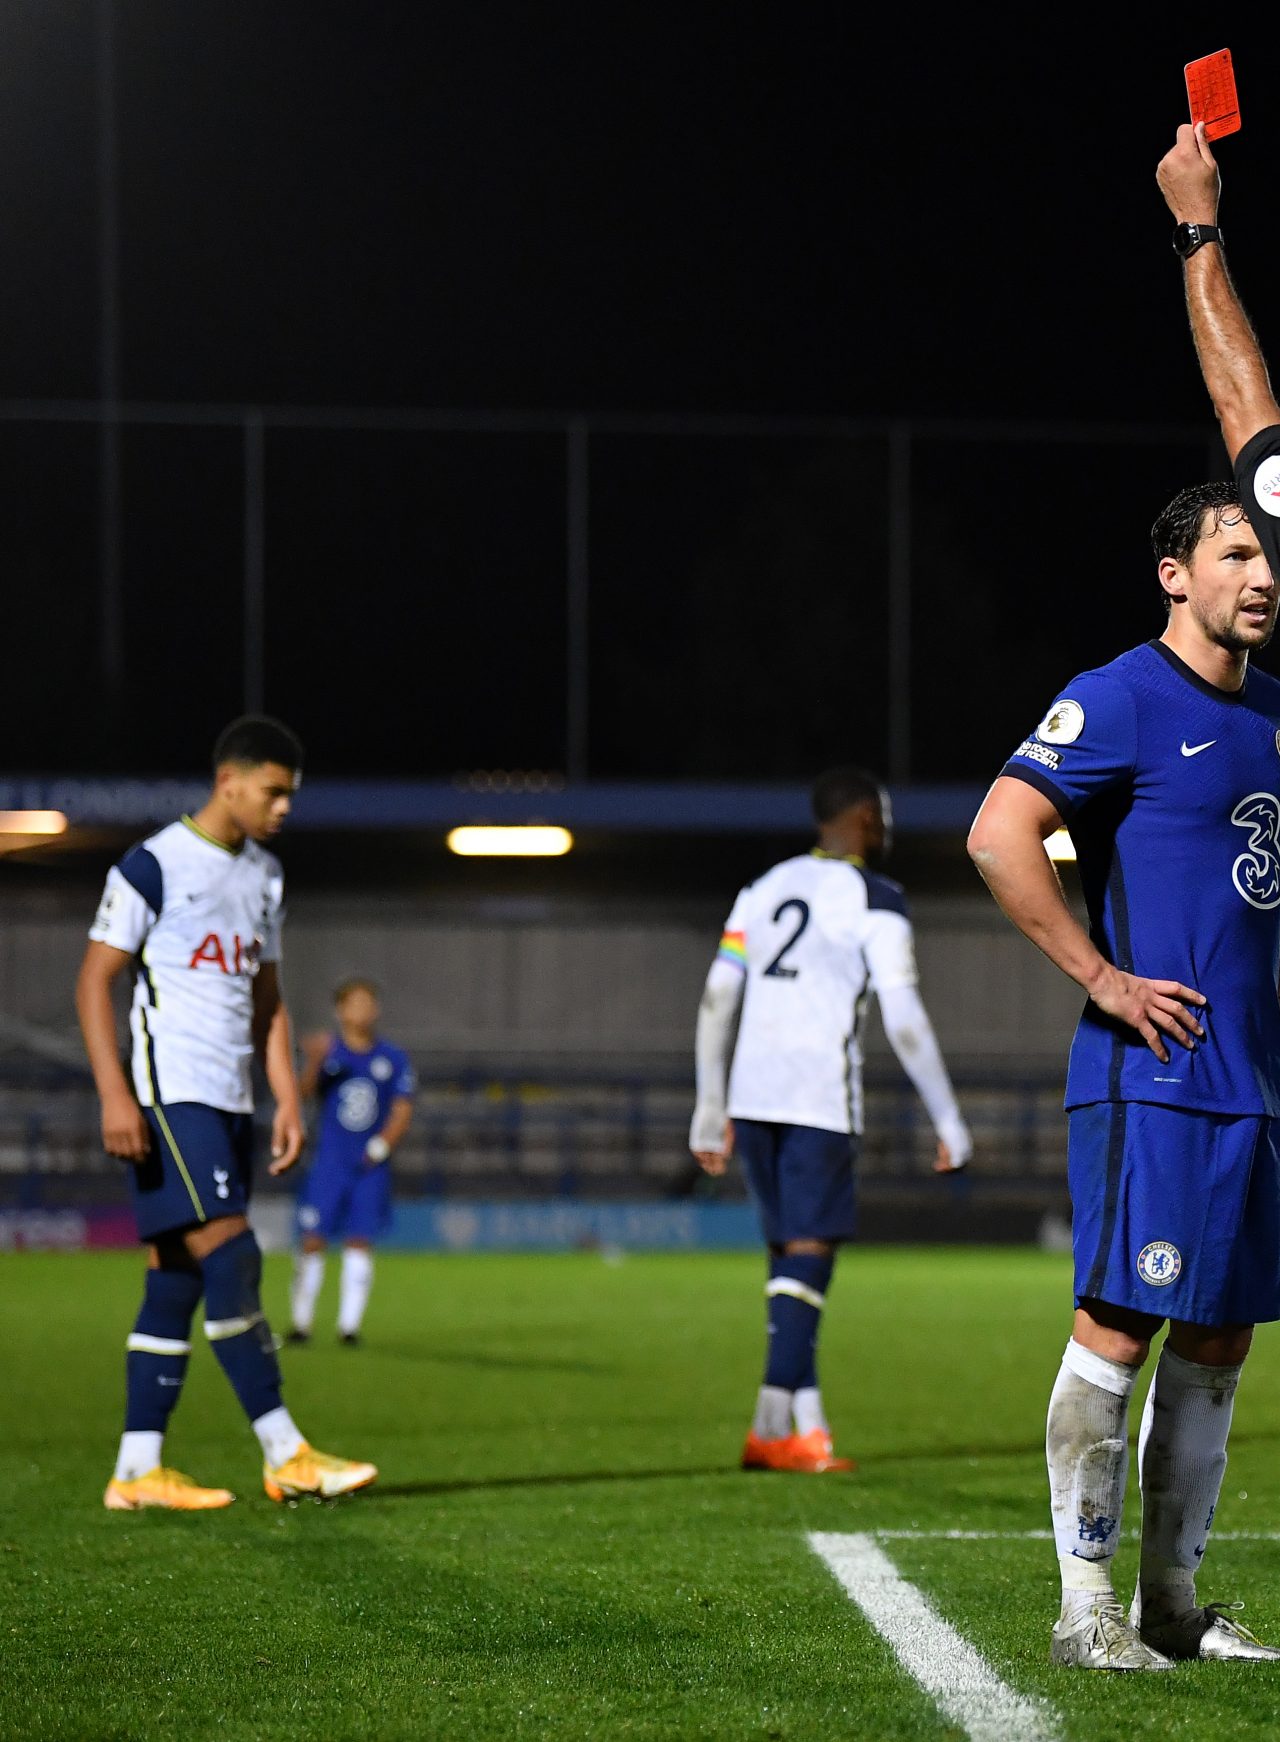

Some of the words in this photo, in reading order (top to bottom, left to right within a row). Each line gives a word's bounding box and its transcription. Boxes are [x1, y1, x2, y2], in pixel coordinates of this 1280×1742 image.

[1030, 743, 1059, 762] room
[763, 898, 810, 979] 2
[1147, 1243, 1177, 1255] CHELSEA
